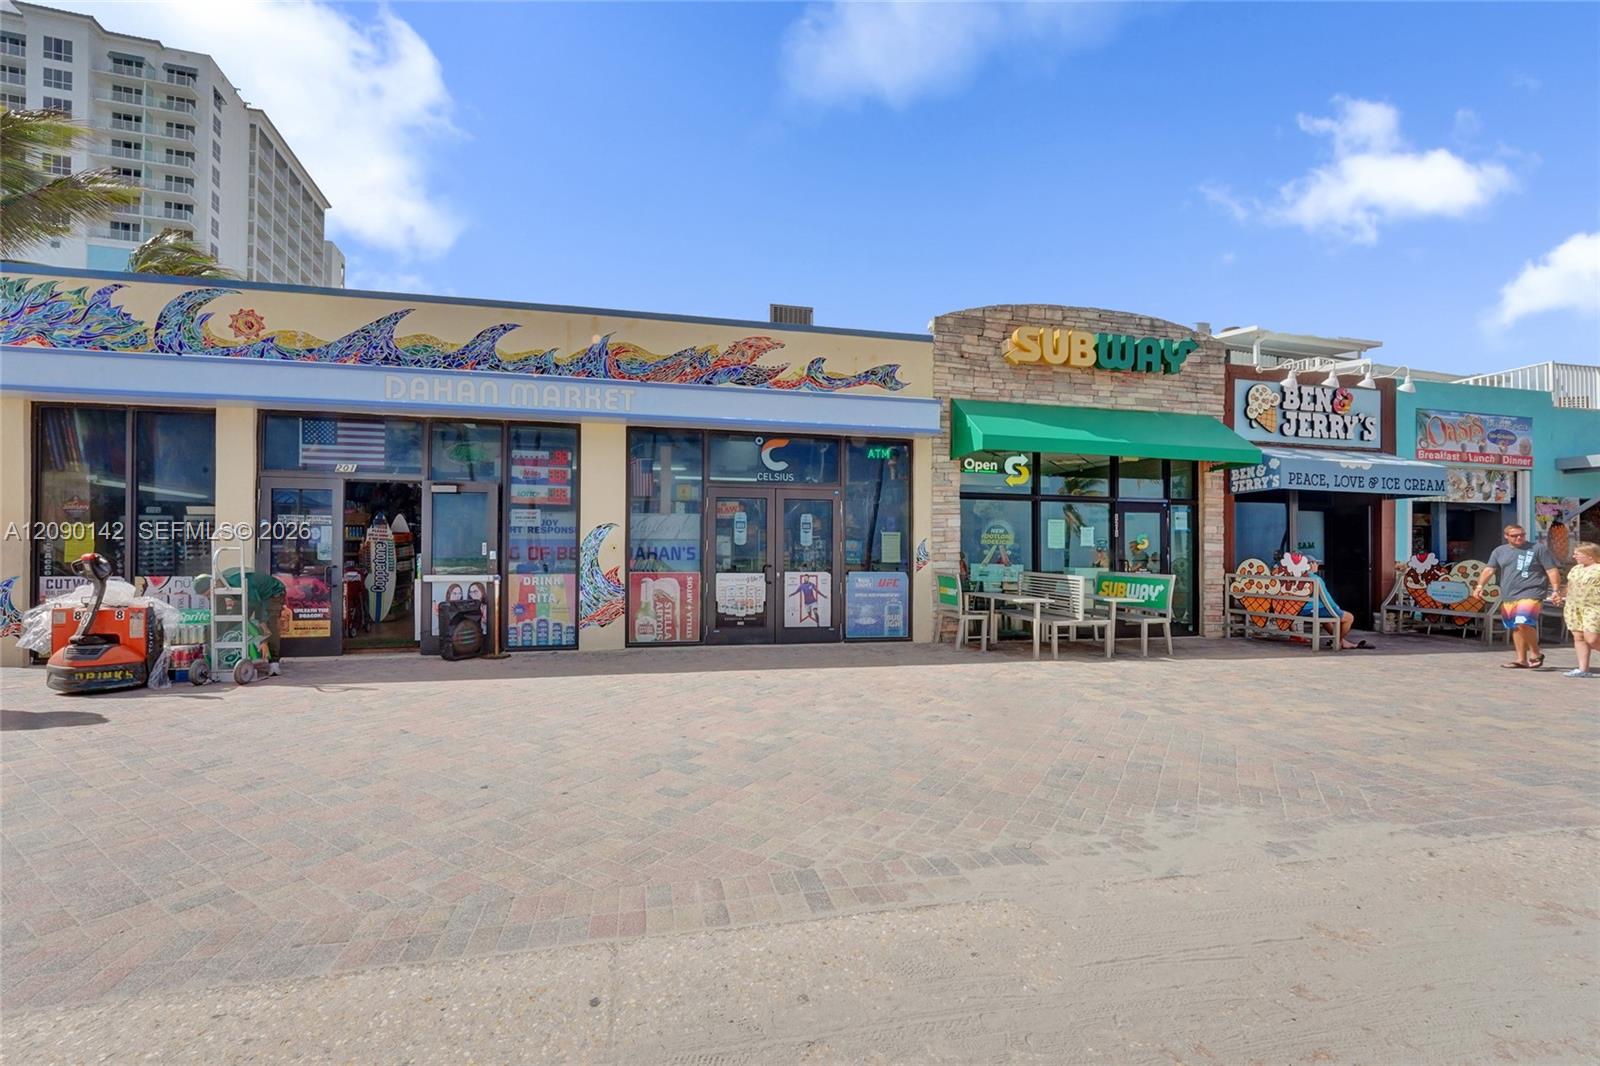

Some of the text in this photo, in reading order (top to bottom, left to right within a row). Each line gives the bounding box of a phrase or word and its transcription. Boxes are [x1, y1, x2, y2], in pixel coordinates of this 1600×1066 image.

[1003, 326, 1198, 374] SUBWAY
[385, 374, 638, 412] DAHAN MARKET
[1282, 384, 1332, 412] BEN
[1281, 411, 1377, 441] JERRY'S
[867, 449, 891, 459] ATM
[1418, 450, 1532, 466] Breakfast Lunch Dinner
[336, 464, 357, 472] 201
[963, 458, 998, 472] Open
[757, 473, 794, 482] CELSIUS
[1231, 466, 1256, 481] BEN
[1231, 474, 1280, 493] JERRY'S
[1288, 472, 1330, 489] PEACE,
[1334, 475, 1365, 489] LOVE
[1382, 478, 1400, 490] ICE
[1404, 478, 1446, 492] CREAM
[528, 527, 576, 535] RESPONS
[631, 546, 696, 560] AHAN'S
[372, 541, 389, 593] Coppertone
[523, 577, 560, 586] DRINK
[877, 578, 899, 588] UFC
[1100, 580, 1165, 601] SUBWAY
[75, 611, 81, 620] 8
[116, 611, 123, 619] 8
[656, 602, 664, 641] ARTOIS
[664, 601, 673, 640] STELLA
